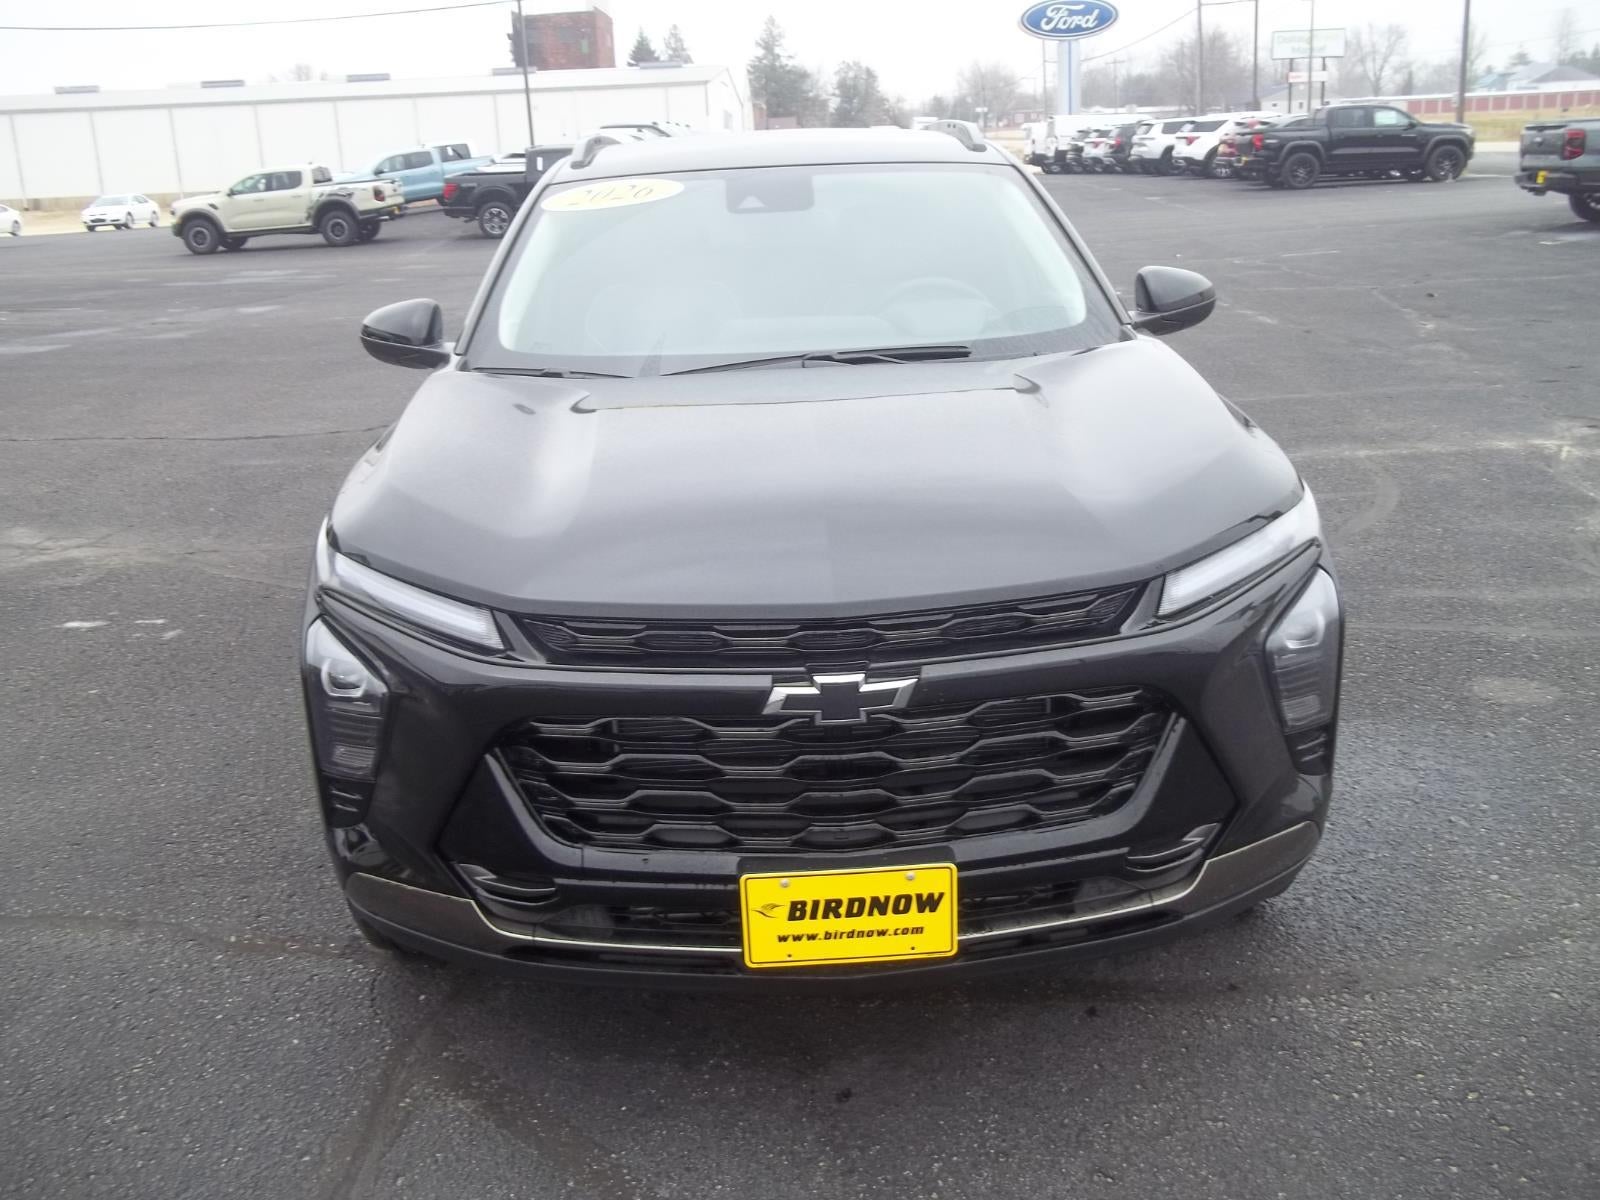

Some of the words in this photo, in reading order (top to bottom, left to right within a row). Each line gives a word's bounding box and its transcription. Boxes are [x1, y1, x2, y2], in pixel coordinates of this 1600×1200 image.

[1041, 4, 1100, 31] Ford
[566, 183, 656, 206] 2026
[787, 892, 945, 922] BIRDNOW
[777, 925, 924, 943] www.birdnow.com
